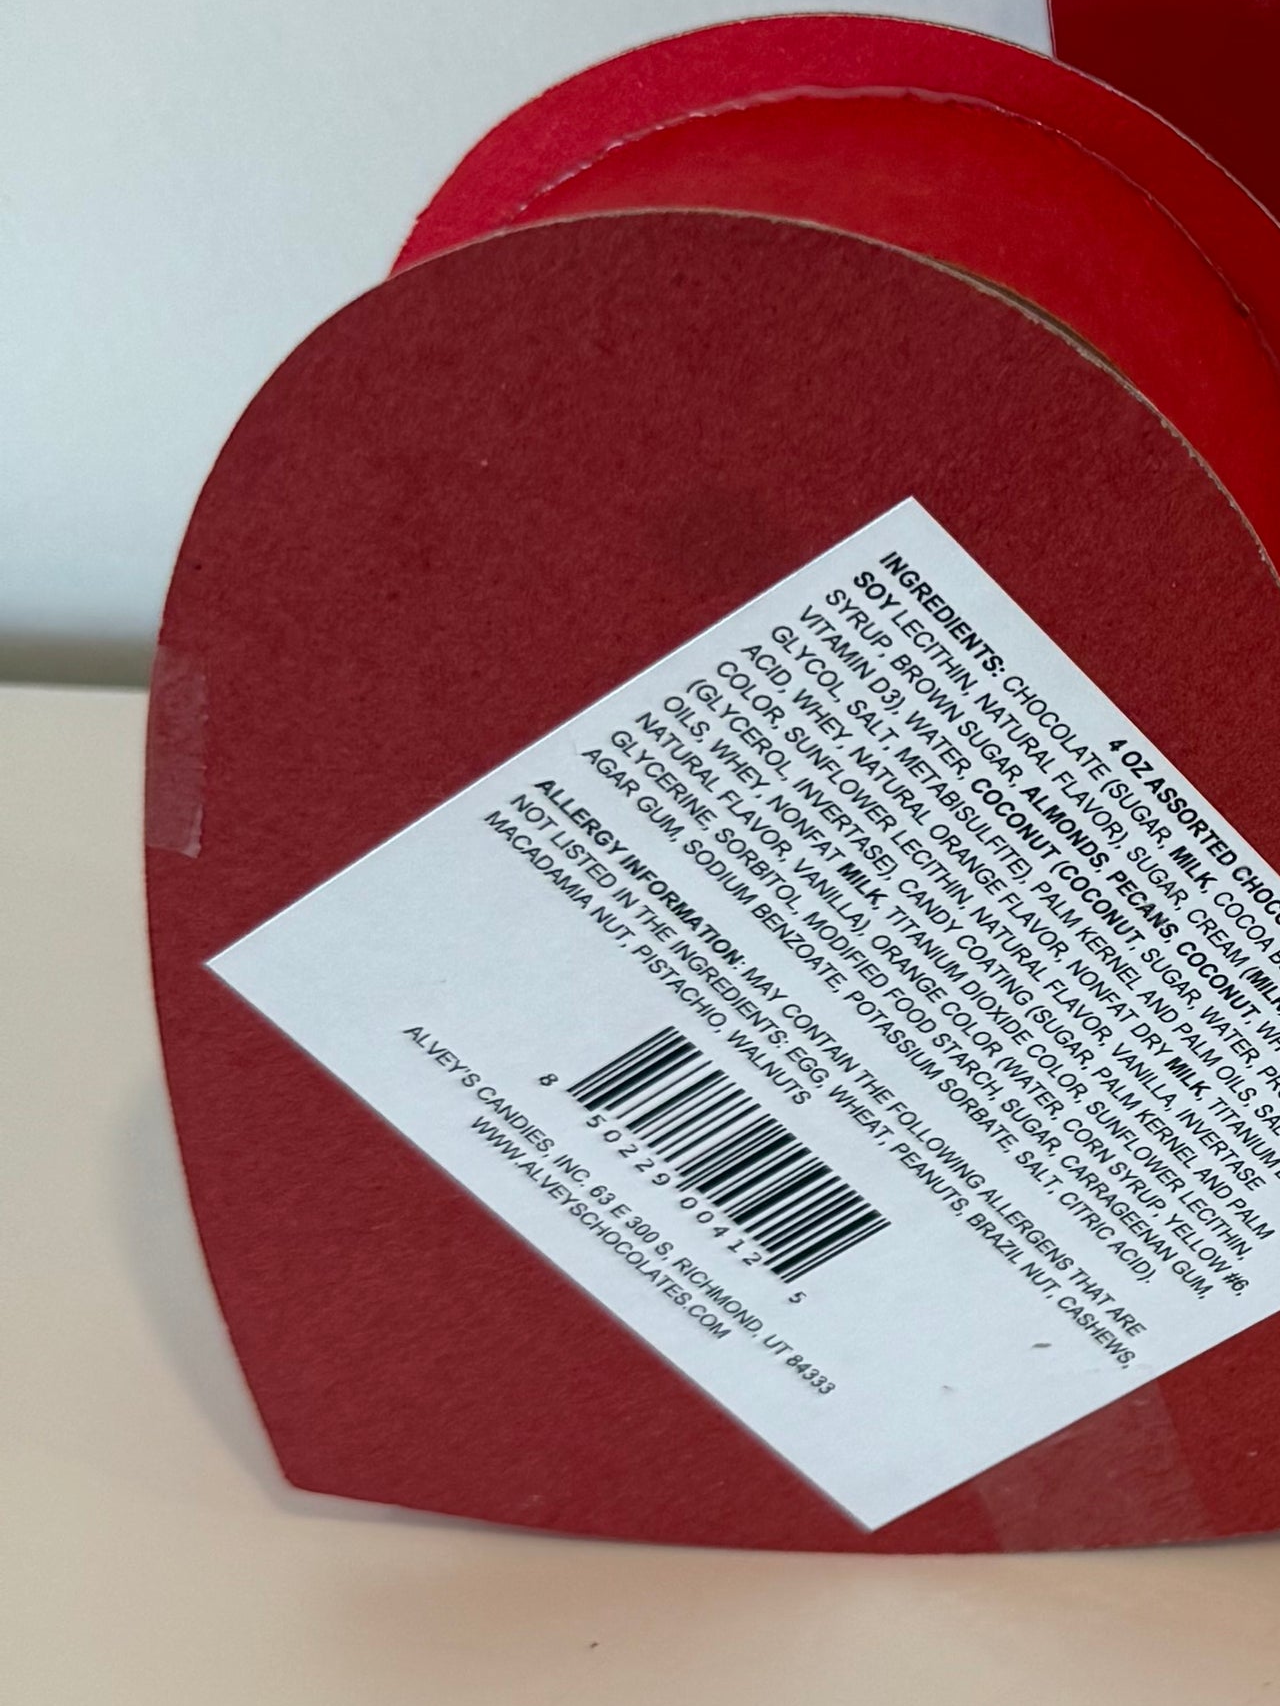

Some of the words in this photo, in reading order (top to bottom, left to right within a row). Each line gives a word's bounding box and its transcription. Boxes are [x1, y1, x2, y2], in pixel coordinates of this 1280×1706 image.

[852, 570, 902, 611] SOY
[889, 608, 978, 697] LECITHIN,
[972, 692, 1056, 775] NATURAL
[1050, 769, 1128, 850] FLAVOR),
[1125, 845, 1189, 912] SUGAR,
[1185, 908, 1251, 968] CREAM
[878, 550, 1005, 678] INGREDIENTS:
[1002, 675, 1112, 782] CHOCOLATE
[1098, 778, 1172, 850] (SUGAR,
[1167, 844, 1218, 894] MILK,
[1212, 891, 1275, 953] COCOA
[1107, 739, 1128, 752] 4
[1120, 750, 1154, 780] OZ
[1142, 777, 1238, 867] ASSORTED
[401, 1026, 481, 1088] ALVEY'S
[475, 1086, 555, 1158] CANDIES,
[551, 1153, 590, 1187] INC.
[587, 1184, 616, 1206] 63
[608, 1203, 632, 1219] E
[623, 1215, 660, 1244] 300
[653, 1241, 674, 1261] S,
[670, 1256, 763, 1338] RICHMOND,
[761, 1333, 793, 1355] UT
[784, 1354, 836, 1395] 84333
[469, 1115, 731, 1339] WWW.ALVEYSCHOCOLATES.COM
[532, 779, 629, 855] ALLERGY
[617, 853, 746, 970] INFORMATION:
[739, 966, 789, 1002] MAY
[780, 1003, 861, 1073] CONTAIN
[852, 1068, 896, 1105] THE
[884, 1100, 986, 1190] FOLLOWING
[975, 1188, 1074, 1271] ALLERGENS
[1067, 1267, 1116, 1306] THAT
[1104, 1306, 1147, 1337] ARE
